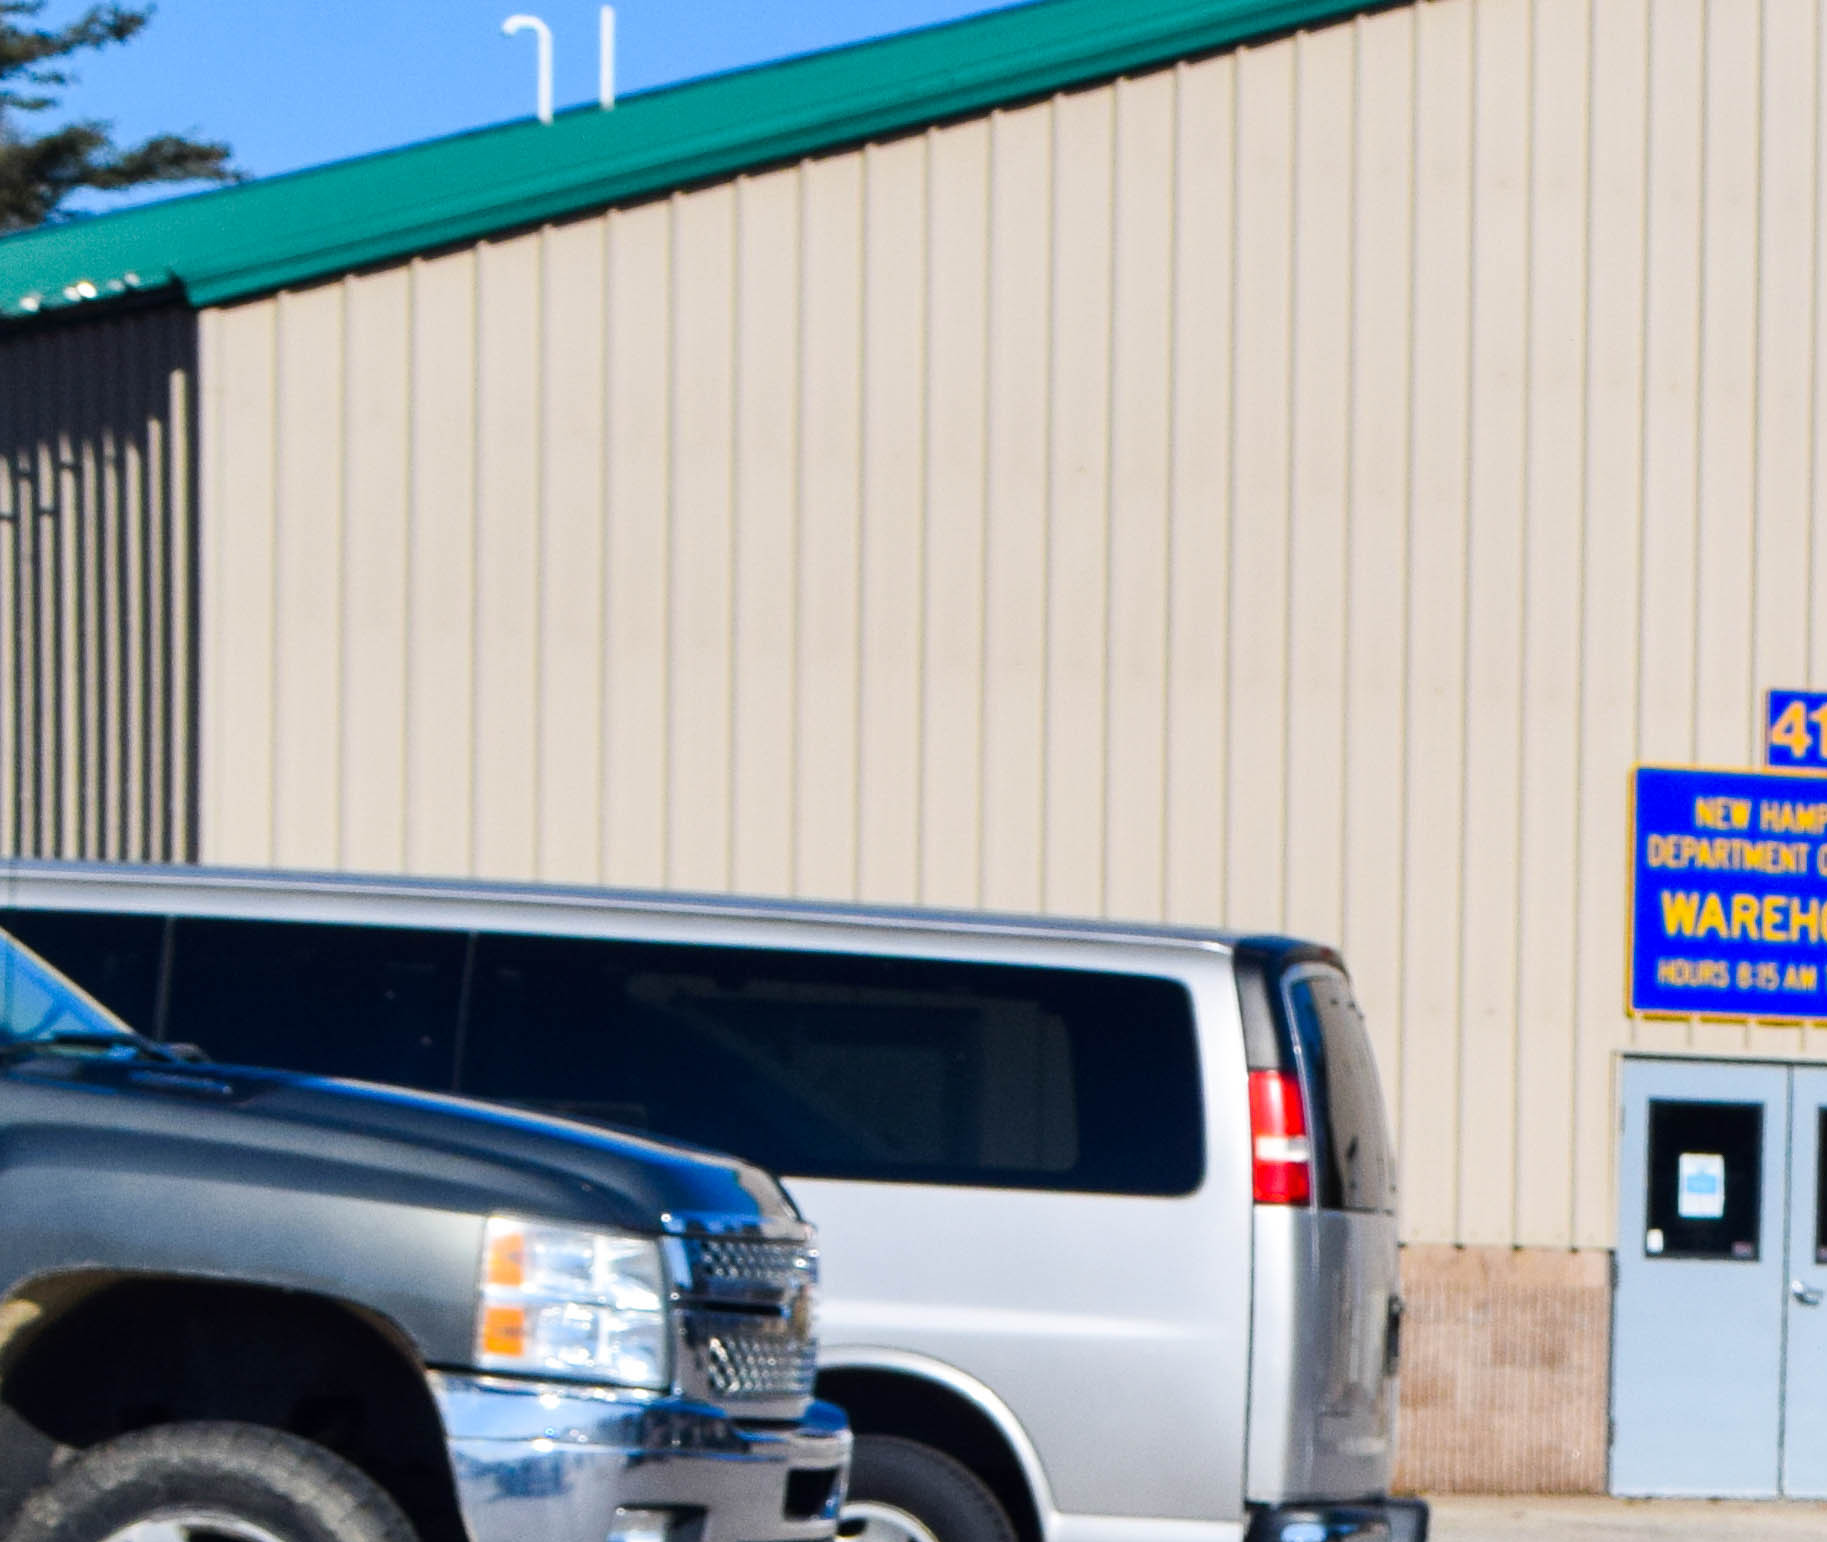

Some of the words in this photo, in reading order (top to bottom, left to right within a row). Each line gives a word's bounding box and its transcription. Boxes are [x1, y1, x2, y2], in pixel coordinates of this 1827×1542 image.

[1694, 796, 1752, 830] NEW
[1647, 833, 1811, 876] DEPARTMENT
[1657, 958, 1730, 989] HOURS
[1735, 961, 1780, 991] 8:15
[1782, 965, 1818, 992] AM
